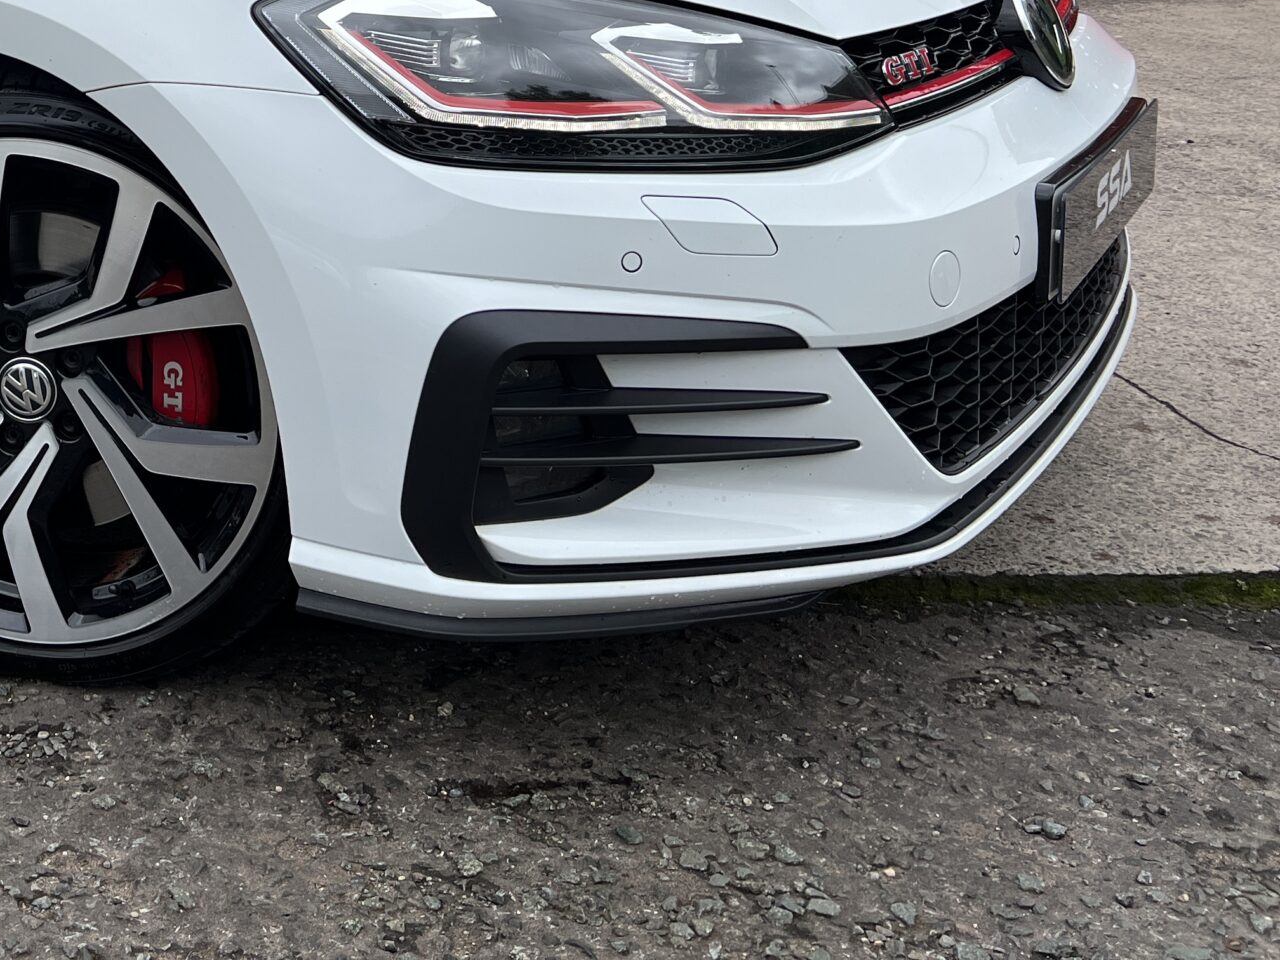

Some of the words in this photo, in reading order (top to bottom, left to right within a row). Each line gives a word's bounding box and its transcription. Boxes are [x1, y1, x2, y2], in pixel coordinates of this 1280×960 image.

[881, 47, 935, 86] GTI
[1095, 149, 1133, 230] SSA
[163, 361, 183, 423] GT
